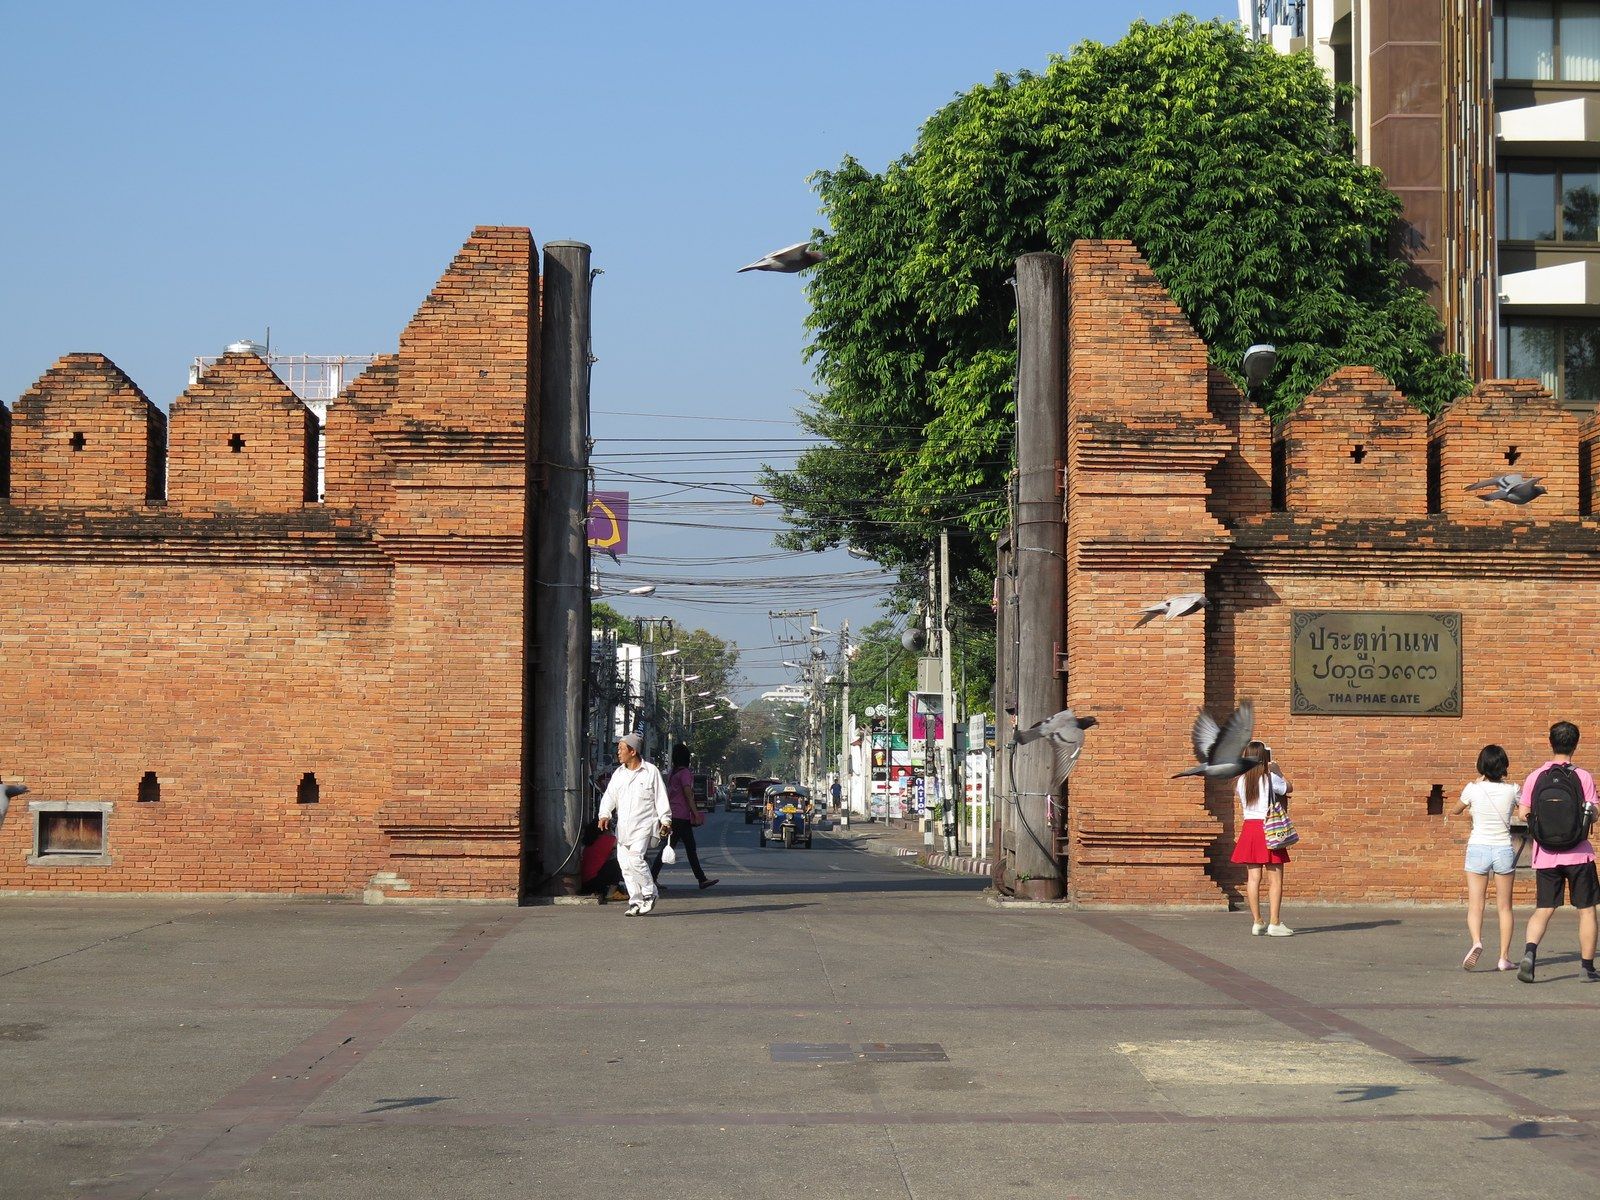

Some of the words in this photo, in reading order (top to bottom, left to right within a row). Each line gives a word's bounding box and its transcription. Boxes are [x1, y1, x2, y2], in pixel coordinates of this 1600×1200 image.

[1309, 626, 1439, 661] ประตูท่าแพ
[1328, 693, 1353, 704] THA
[1355, 694, 1387, 704] PHAE
[1390, 694, 1421, 704] GATE
[916, 777, 925, 815] TATTOO
